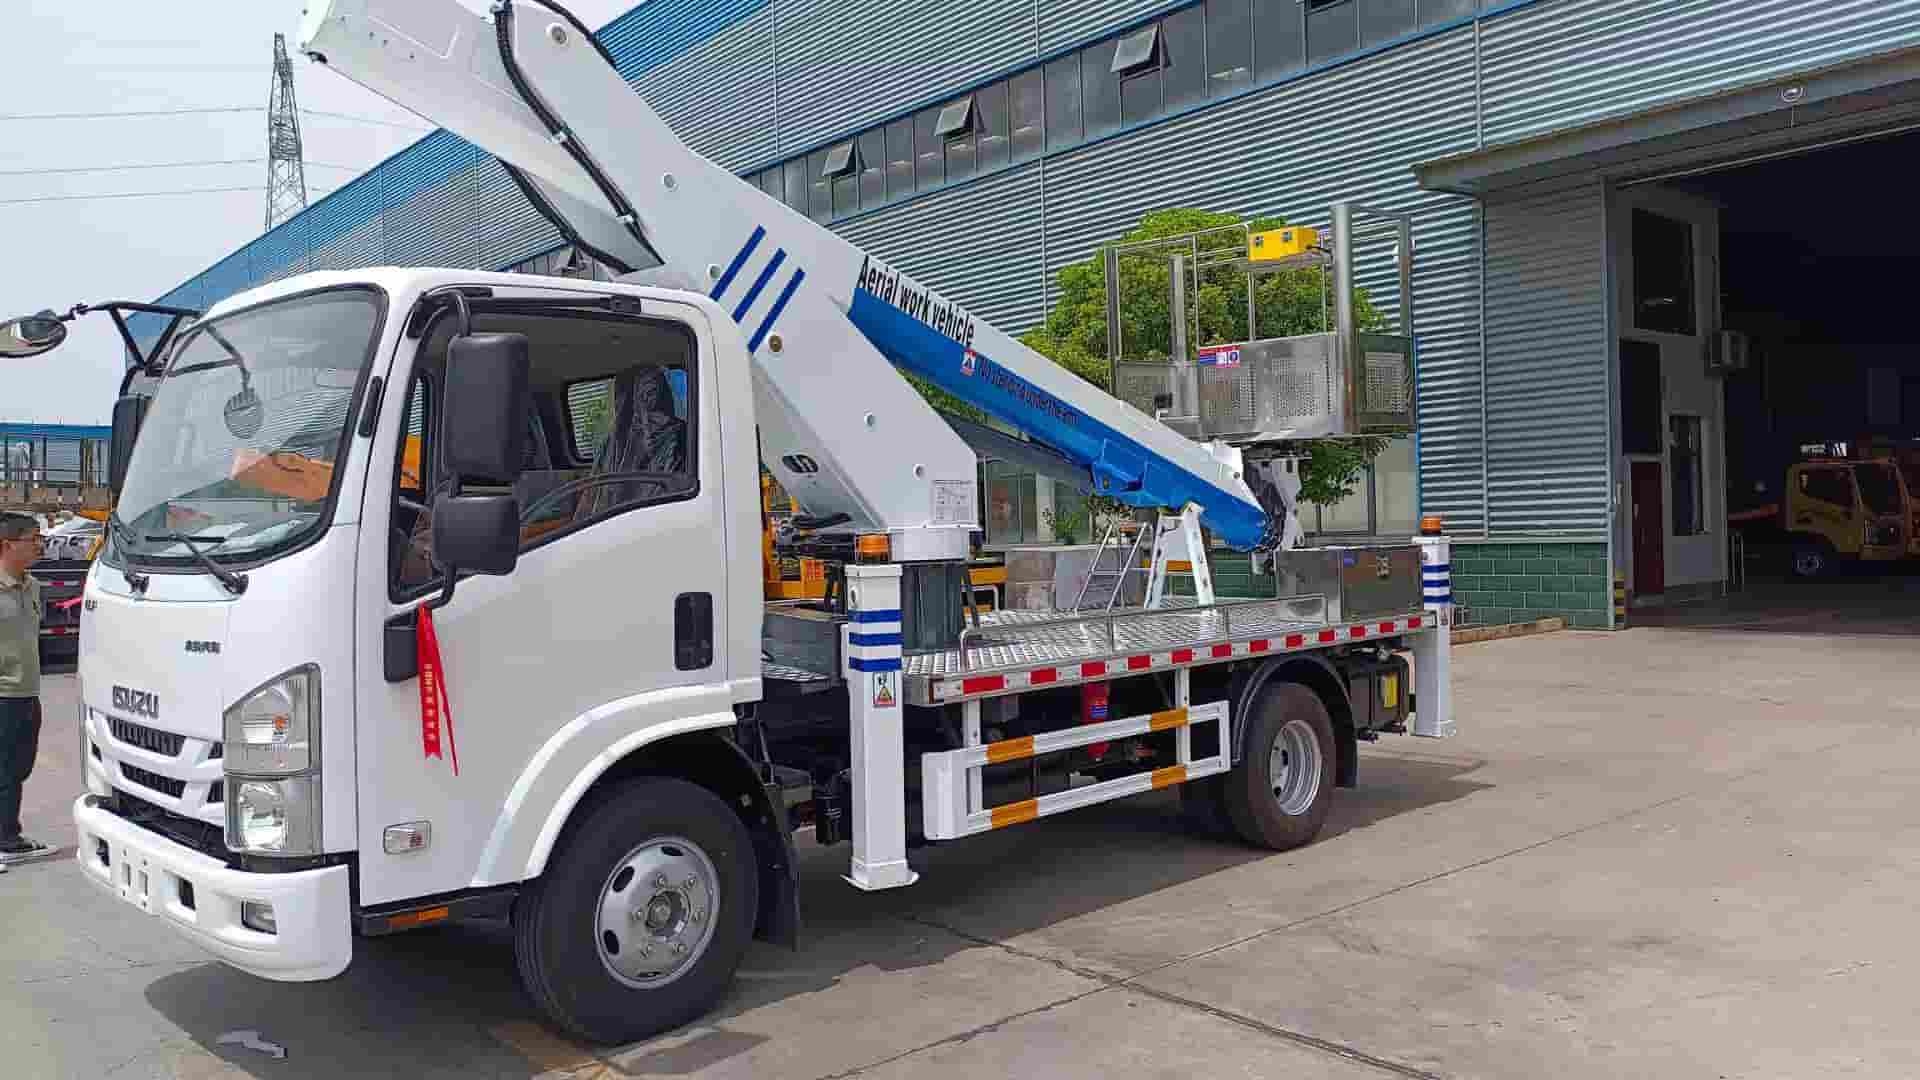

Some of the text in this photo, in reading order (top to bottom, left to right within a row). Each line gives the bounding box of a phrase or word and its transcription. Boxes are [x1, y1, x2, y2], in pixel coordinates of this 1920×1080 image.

[856, 255, 975, 348] Aerial work vehicle
[112, 686, 160, 719] ISUZU
